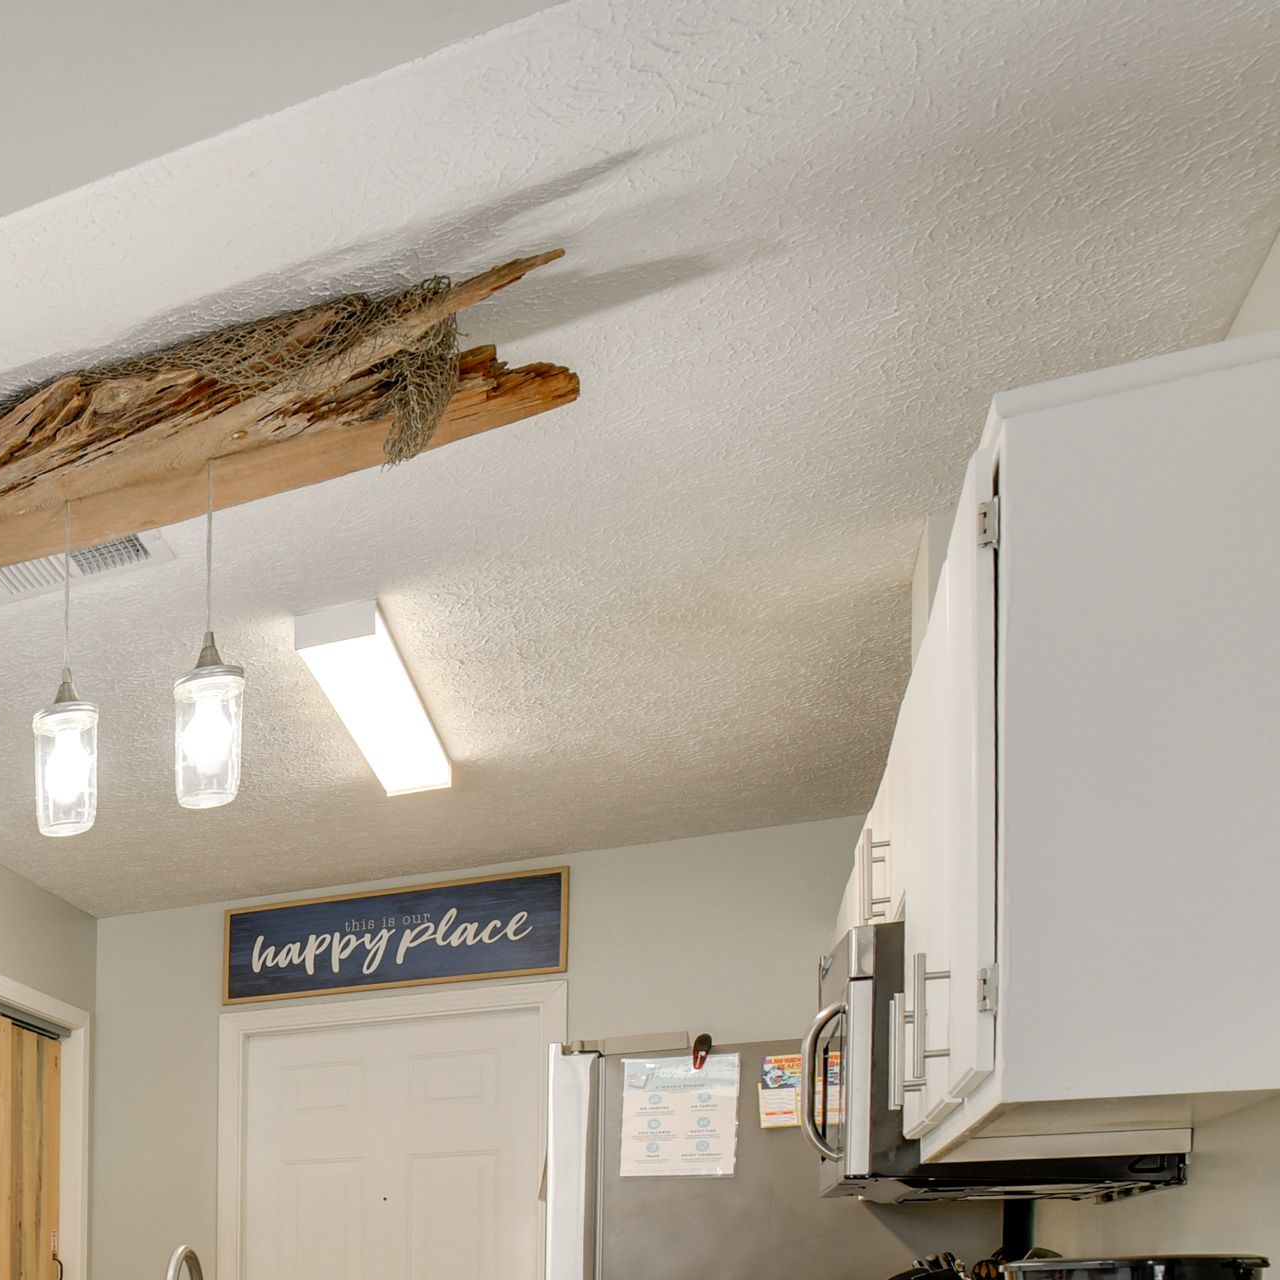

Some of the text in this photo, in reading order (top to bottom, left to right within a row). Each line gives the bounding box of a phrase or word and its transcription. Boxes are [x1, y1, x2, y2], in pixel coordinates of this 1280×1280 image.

[250, 906, 534, 976] happy place
[344, 912, 432, 933] this is our
